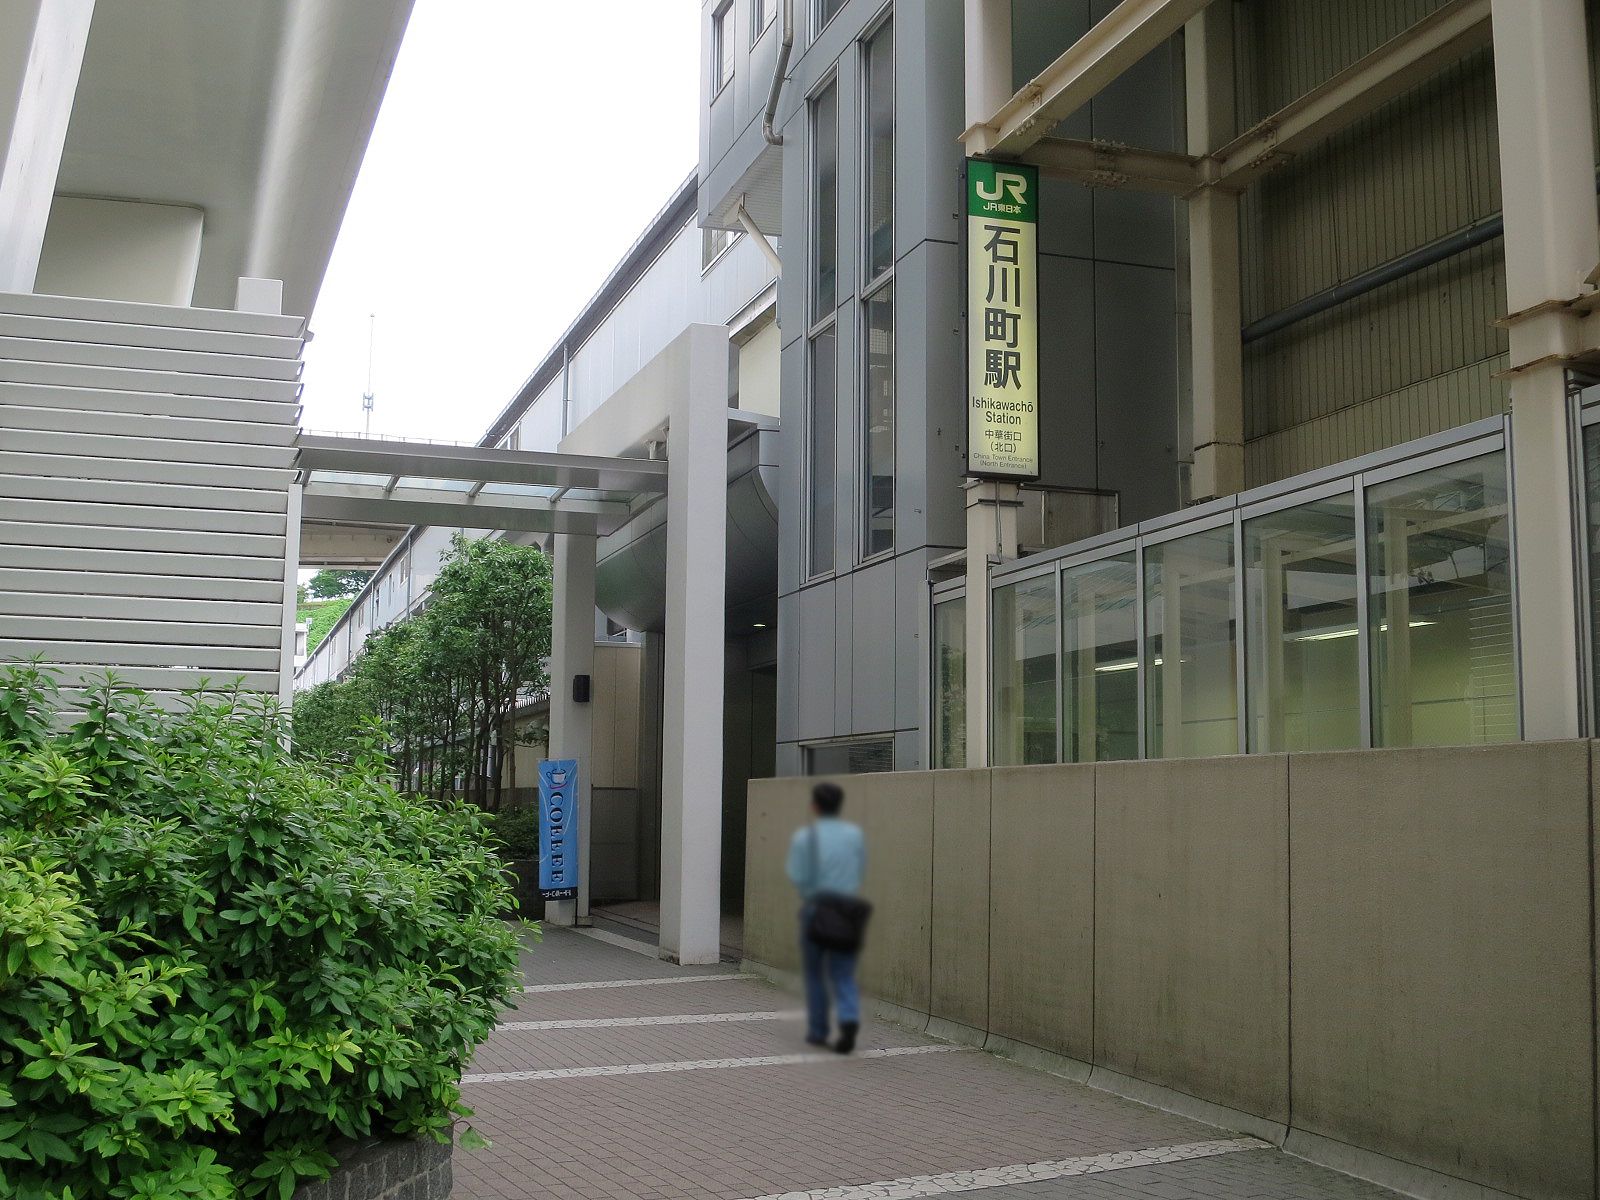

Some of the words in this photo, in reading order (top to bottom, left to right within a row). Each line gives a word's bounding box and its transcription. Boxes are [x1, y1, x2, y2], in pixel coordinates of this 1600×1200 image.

[976, 172, 1027, 205] JR
[983, 202, 1022, 214] JR東日本
[983, 224, 1022, 390] 石川町駅
[972, 396, 1034, 413] Ishikawachō
[985, 411, 1022, 425] Station
[985, 429, 1022, 441] 中華街口
[973, 452, 990, 460] China
[980, 460, 999, 468] (North
